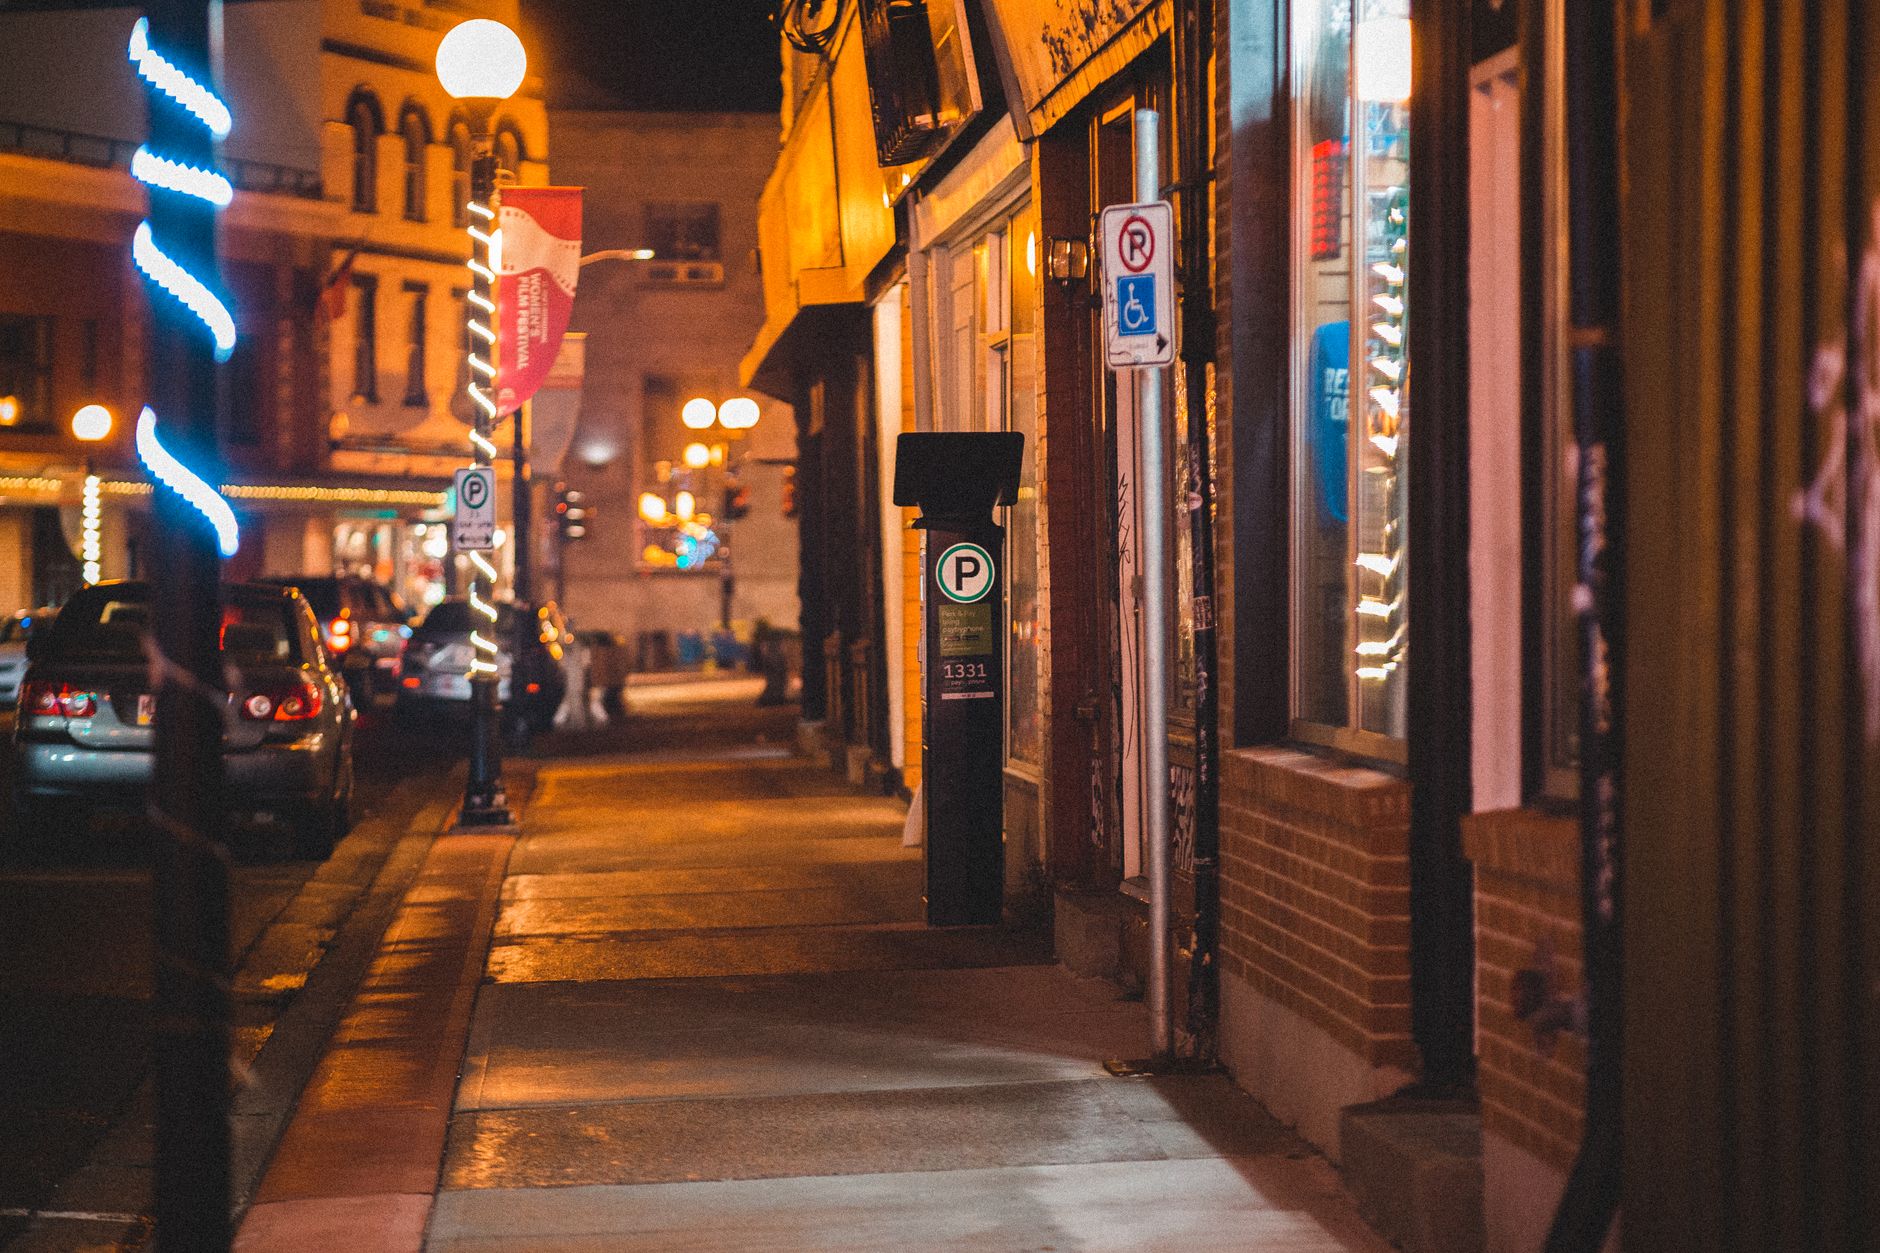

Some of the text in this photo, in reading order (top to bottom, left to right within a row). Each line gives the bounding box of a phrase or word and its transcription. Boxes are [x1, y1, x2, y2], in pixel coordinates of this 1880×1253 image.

[1129, 229, 1147, 262] P
[529, 273, 542, 338] WOMEN'S
[517, 276, 530, 370] FILM FESTIVAL
[469, 480, 482, 501] P
[955, 556, 981, 591] P
[944, 663, 987, 679] 1331
